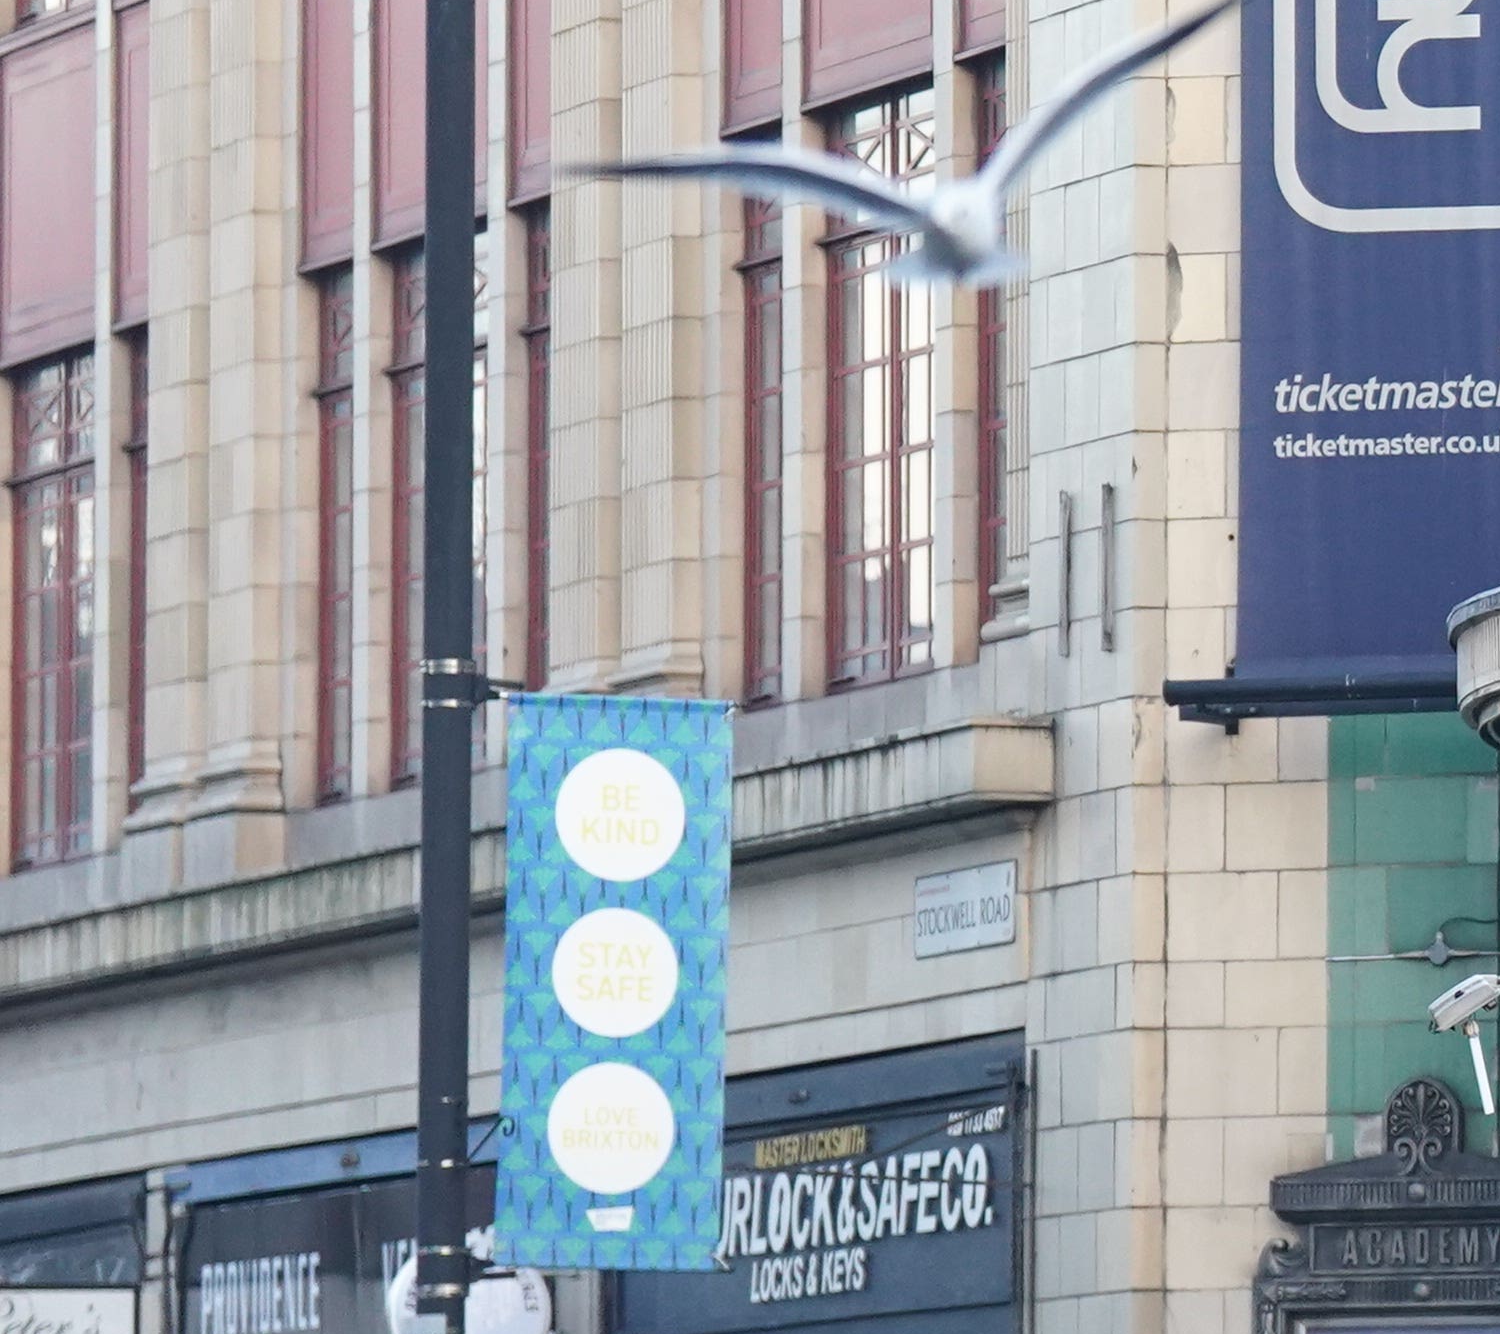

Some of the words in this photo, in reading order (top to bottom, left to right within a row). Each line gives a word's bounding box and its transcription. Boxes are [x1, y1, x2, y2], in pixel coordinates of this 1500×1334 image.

[601, 784, 641, 813] BE
[580, 817, 660, 847] KIND
[917, 899, 976, 937] STOCKWELL
[980, 893, 1011, 925] ROAD
[578, 943, 653, 971] STAY
[576, 973, 654, 1002] SAFE
[583, 1106, 639, 1127] LOVE
[562, 1127, 660, 1151] BRIXTON
[800, 1124, 867, 1164] LOCKSMITH
[1342, 1226, 1500, 1267] ACADEMY
[750, 1254, 804, 1304] LOCKS
[805, 1252, 818, 1297] &
[821, 1246, 867, 1295] KEYS
